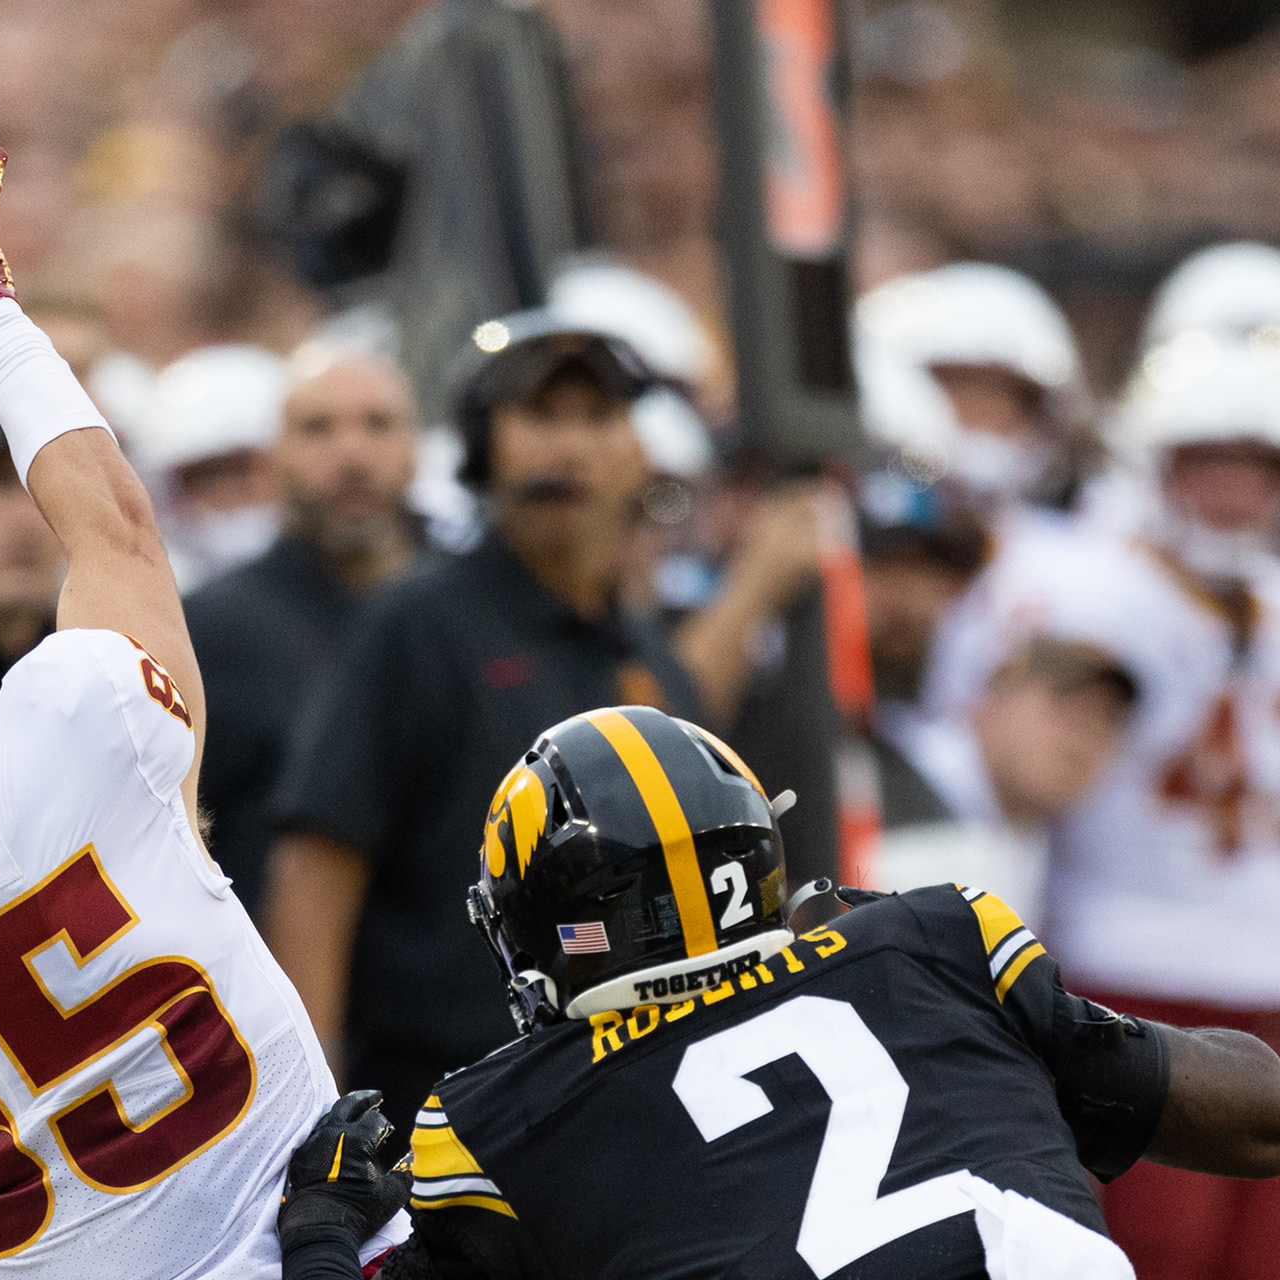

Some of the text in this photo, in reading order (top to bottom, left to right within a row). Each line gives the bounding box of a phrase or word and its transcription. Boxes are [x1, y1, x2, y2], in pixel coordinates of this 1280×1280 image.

[710, 861, 754, 930] 2
[634, 950, 761, 1001] TOGETHER
[672, 995, 978, 1280] 2
